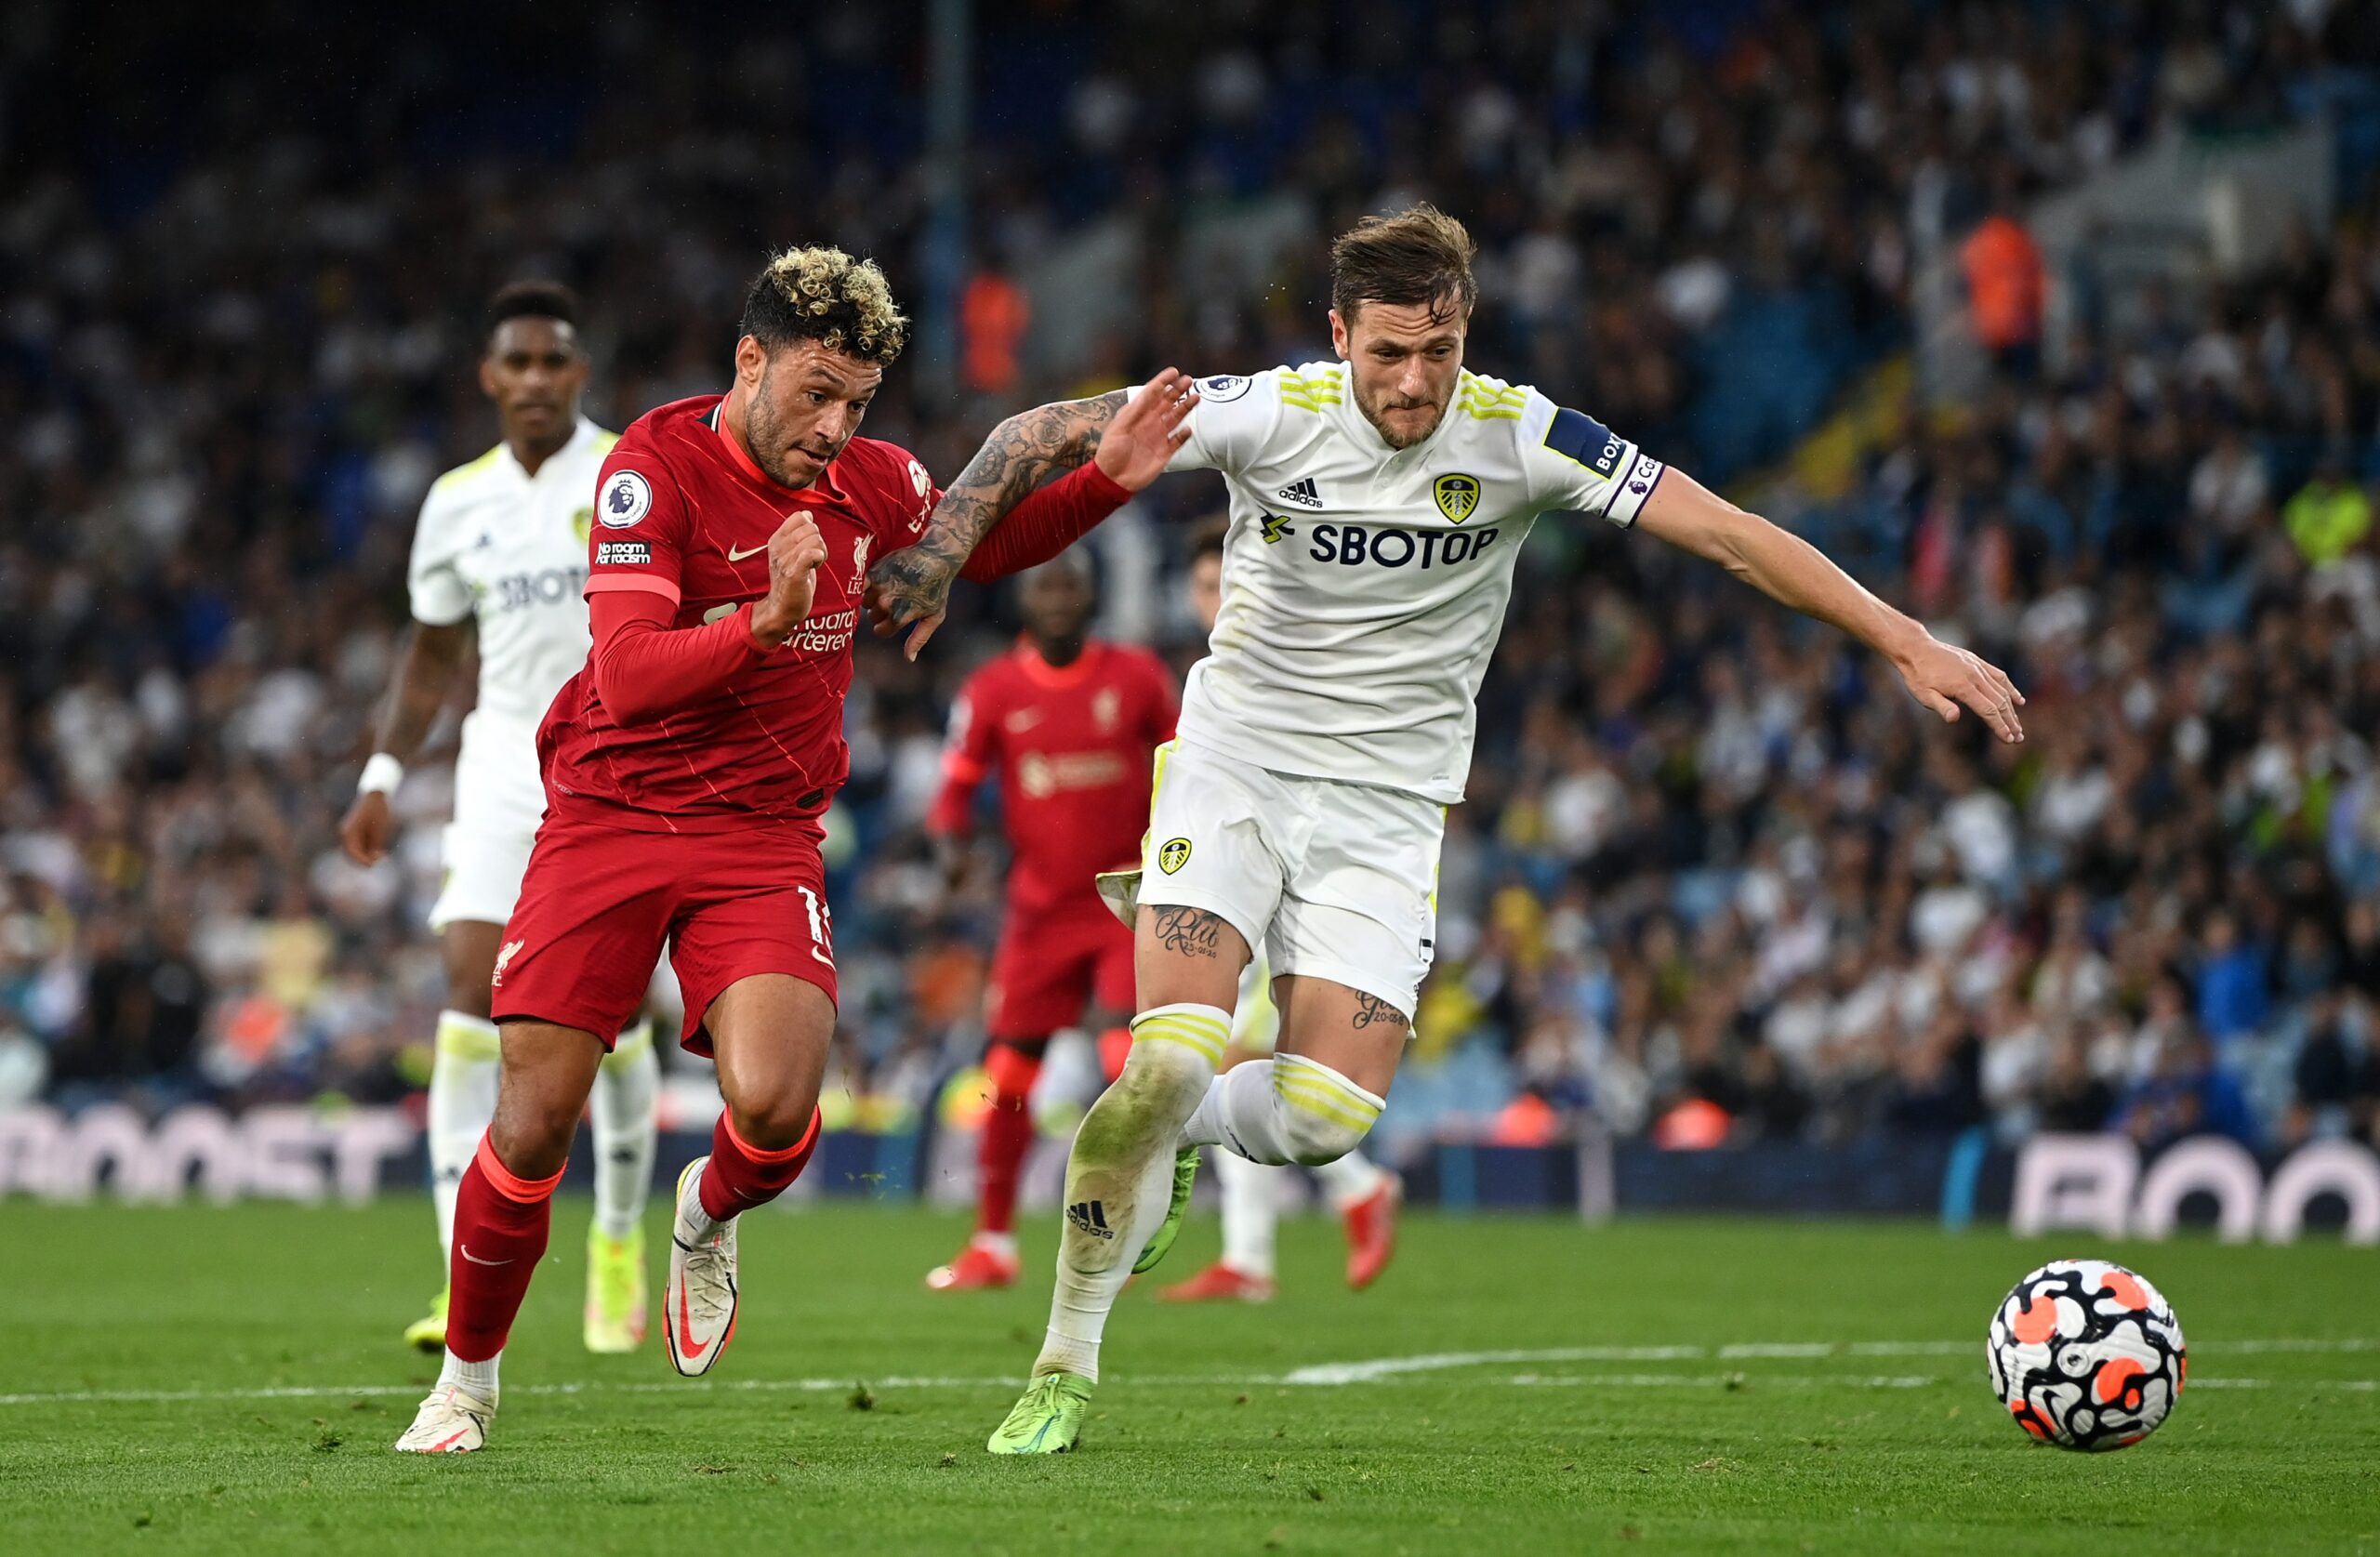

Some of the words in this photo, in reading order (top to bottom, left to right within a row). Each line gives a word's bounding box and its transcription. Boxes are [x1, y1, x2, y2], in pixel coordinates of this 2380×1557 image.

[1279, 489, 1324, 508] adidas
[599, 542, 612, 554] No
[612, 543, 645, 555] room
[1309, 524, 1500, 570] SBOTOP
[611, 554, 651, 564] racism
[847, 581, 863, 594] LFC
[782, 629, 853, 652] artered
[1066, 1208, 1115, 1239] adidas
